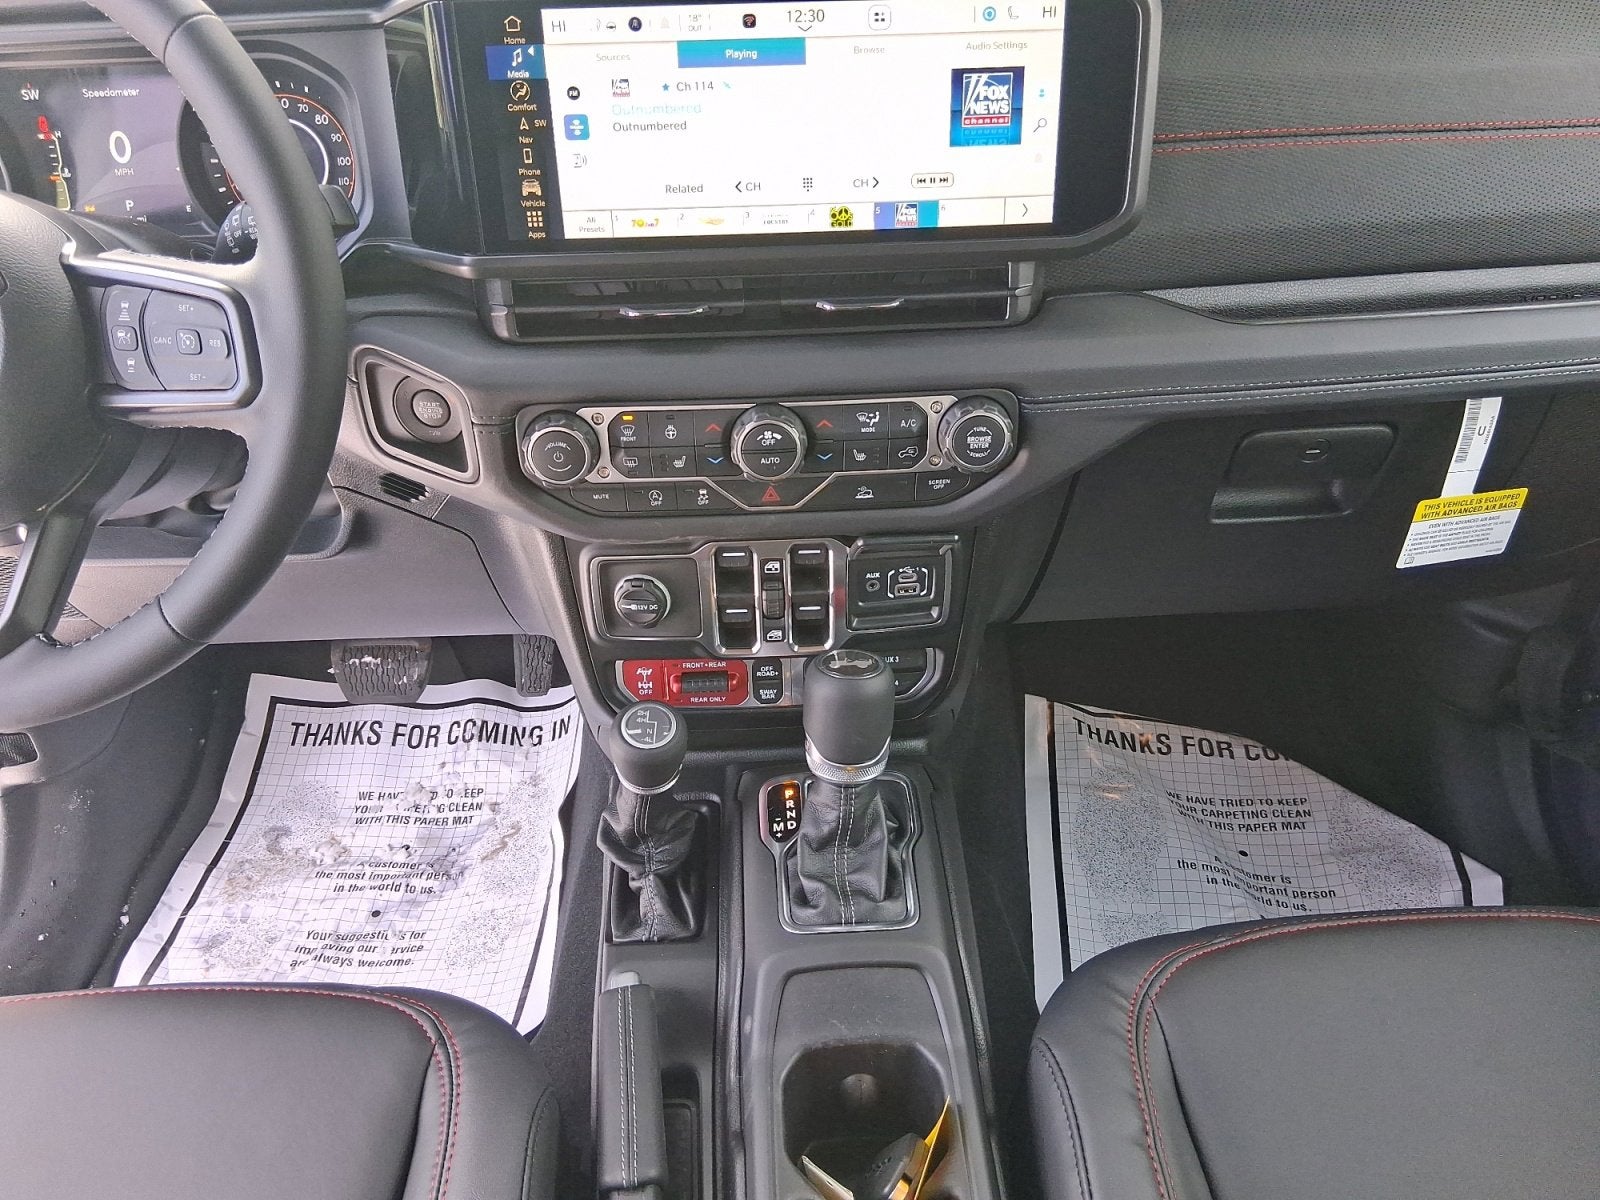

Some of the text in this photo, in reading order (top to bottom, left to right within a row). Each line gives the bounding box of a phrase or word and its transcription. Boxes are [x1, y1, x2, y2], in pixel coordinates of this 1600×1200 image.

[786, 8, 825, 23] 12:30
[1042, 6, 1057, 19] HI
[551, 20, 567, 33] HI
[503, 36, 526, 45] Home
[853, 45, 885, 55] Browse
[965, 39, 1028, 53] Audio Settings
[595, 51, 631, 62] Sources
[725, 48, 758, 60] Playing
[507, 70, 530, 79] Media
[676, 80, 714, 92] Ch 114
[21, 90, 40, 101] SW
[82, 87, 141, 99] Speedometer
[979, 85, 1010, 101] FOX
[297, 104, 309, 113] 70
[507, 103, 538, 112] Comfort
[970, 99, 1010, 115] NEWS
[315, 114, 329, 125] 80
[534, 119, 547, 127] SW
[964, 116, 1009, 125] channel
[613, 120, 688, 132] Outnumbered
[330, 133, 342, 142] 90
[518, 136, 534, 144] Nav
[109, 130, 132, 164] 0
[337, 156, 351, 166] 100
[114, 168, 135, 177] MPH
[518, 168, 541, 176] Phone
[338, 177, 350, 186] 110
[853, 178, 869, 188] CH
[665, 183, 704, 194] Related
[745, 182, 761, 192] CH
[126, 199, 135, 211] P
[520, 199, 546, 208] Vehicle
[875, 206, 880, 214] 5
[831, 219, 854, 228] GOLD
[578, 225, 606, 233] Presets
[528, 230, 546, 240] Apps
[153, 336, 172, 345] CANC
[900, 418, 917, 428] A/C
[761, 438, 776, 446] OFF
[967, 435, 992, 443] BROWSE
[547, 441, 568, 450] VOLUME
[928, 478, 951, 487] SCREEN
[1424, 503, 1441, 511] THIS
[1442, 499, 1476, 510] VEHICLE
[1484, 493, 1521, 504] EQUIPPED
[1421, 501, 1518, 519] WITH ADVANCED AIR BAGS
[290, 720, 383, 748] THANKS
[391, 723, 441, 749] FOR
[551, 715, 571, 742] IN
[1072, 716, 1290, 762] THANKS FOR CO
[358, 791, 375, 801] WE
[460, 788, 484, 799] EEP
[784, 789, 794, 799] P
[1165, 789, 1308, 808] WE HAVE TRIED TO KEEP
[448, 802, 483, 813] CLEAN
[785, 800, 795, 809] R
[786, 810, 796, 819] N
[1169, 800, 1312, 820] YOUR CARPETING CLEAN
[355, 814, 475, 826] WITH THIS PAPER MAT
[787, 820, 797, 830] D
[1177, 807, 1307, 833] WITH THIS PAPER MAT
[773, 822, 784, 832] M
[368, 860, 423, 870] customer
[314, 870, 424, 881] the most important
[1177, 858, 1198, 870] the
[1201, 863, 1232, 878] most
[1291, 889, 1337, 900] person
[1280, 874, 1293, 885] is
[333, 881, 437, 895] in the world to us.
[1206, 874, 1313, 912] in the to us.
[306, 930, 333, 941] Your
[357, 944, 378, 954] our
[311, 952, 354, 968] always
